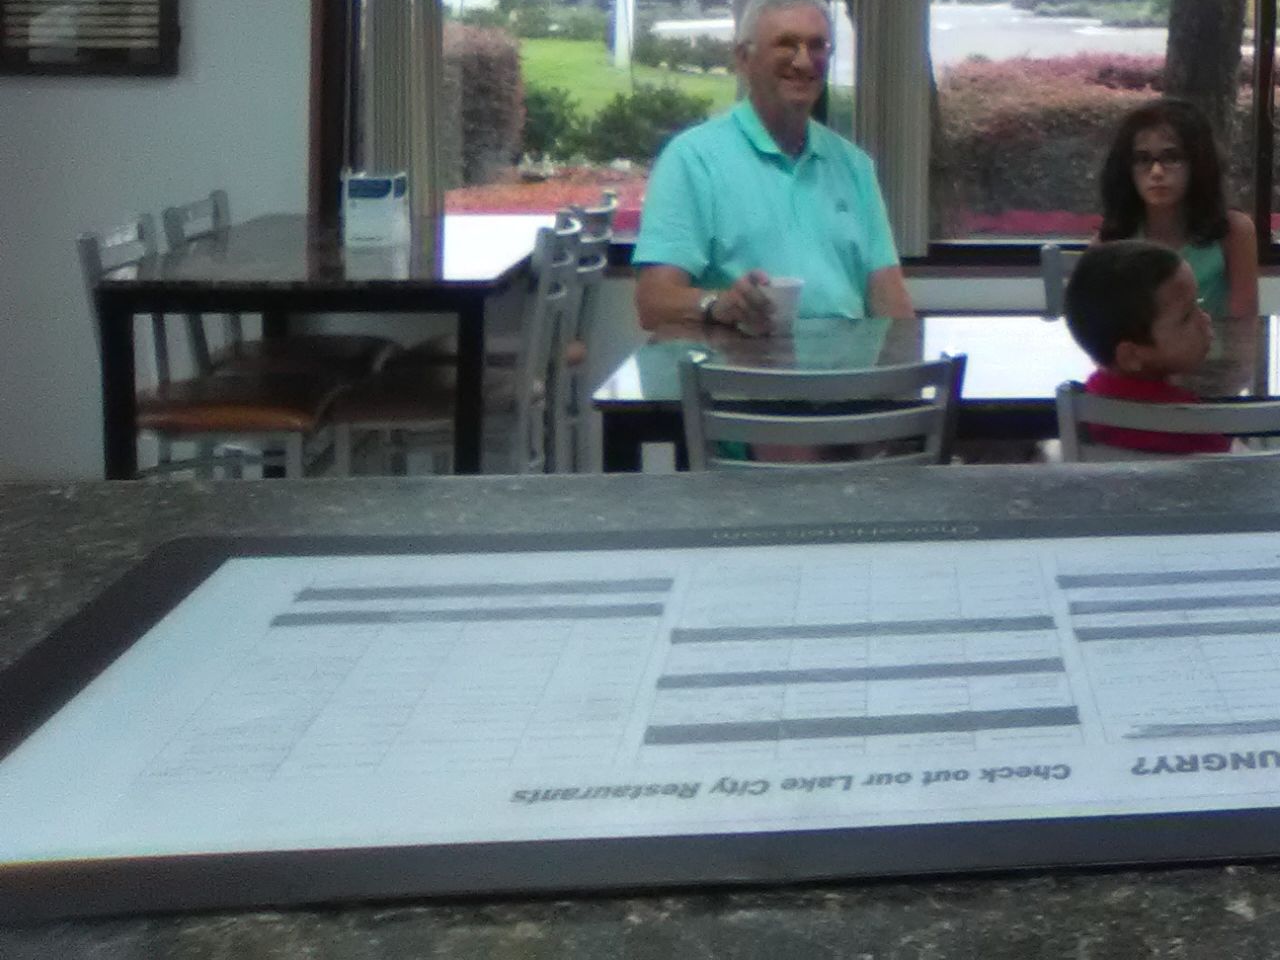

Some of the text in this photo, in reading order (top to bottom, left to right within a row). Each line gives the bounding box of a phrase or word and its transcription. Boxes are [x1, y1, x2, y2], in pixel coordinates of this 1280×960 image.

[780, 775, 854, 792] Lake
[861, 771, 913, 787] our
[921, 768, 970, 787] out
[979, 763, 1071, 784] Check
[509, 782, 701, 805] Restaurants
[708, 776, 770, 797] City
